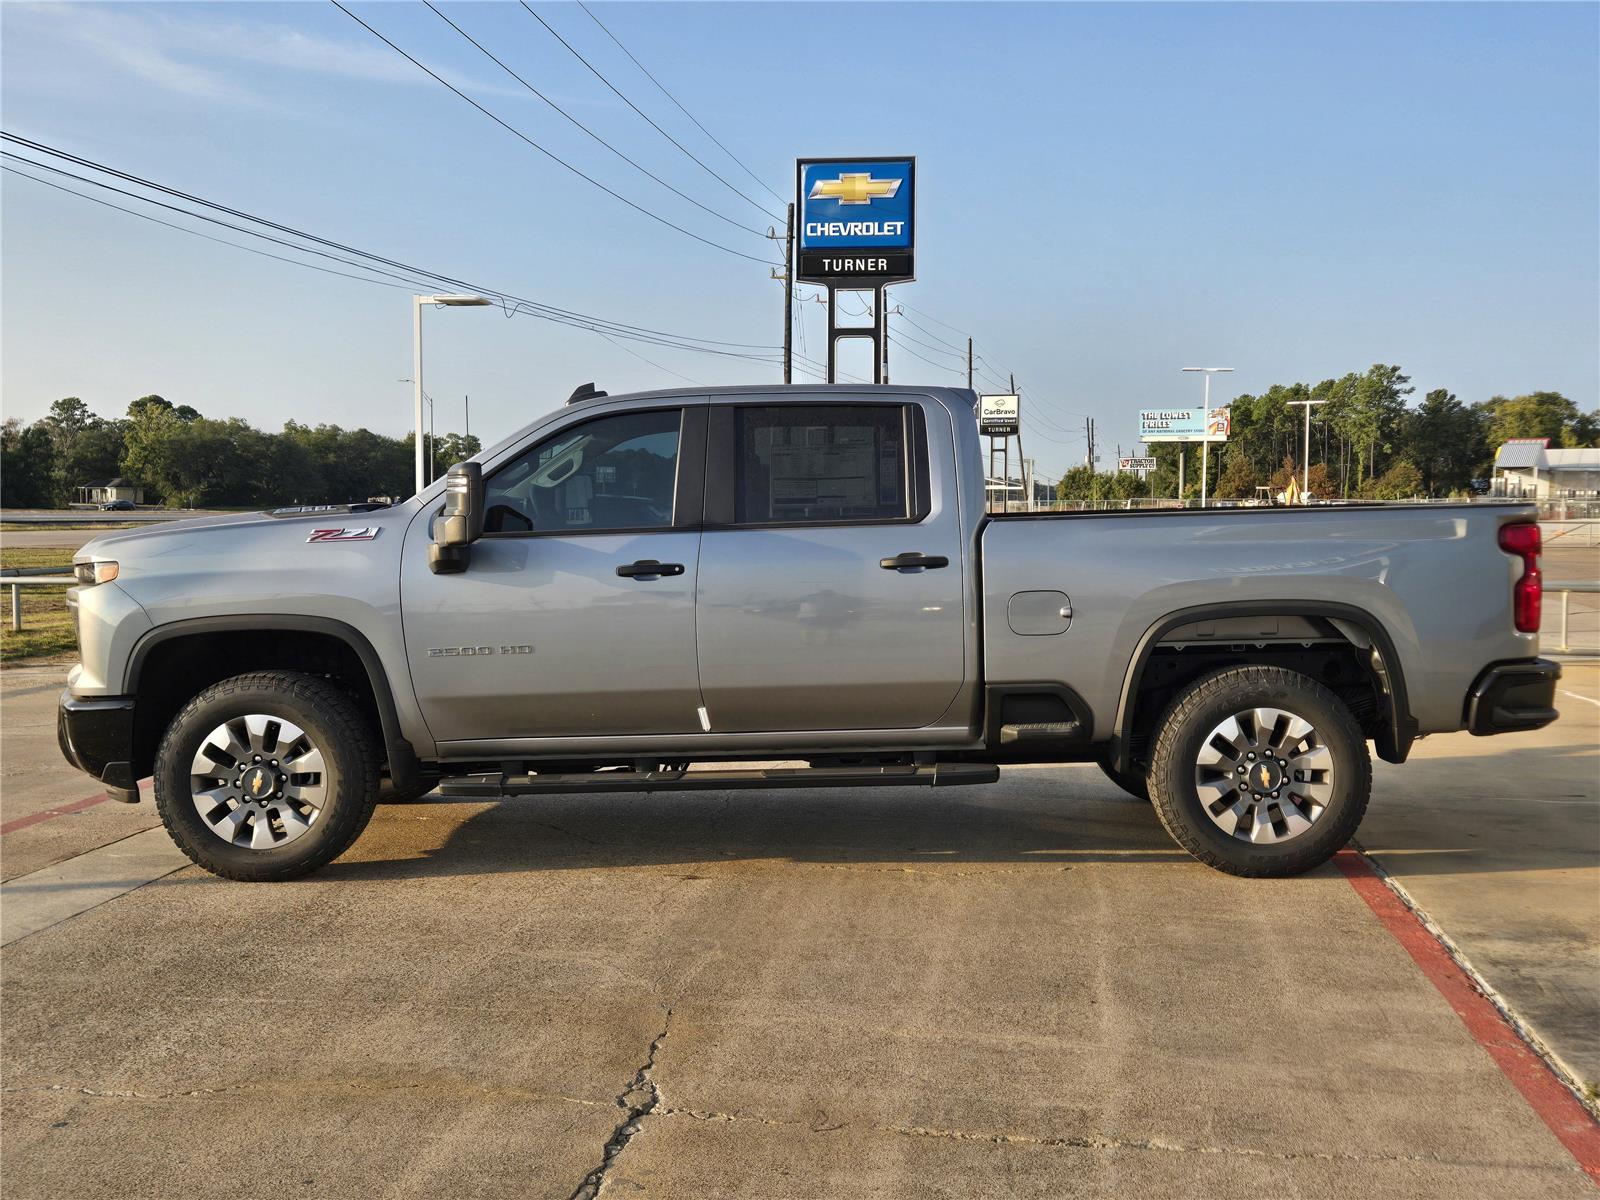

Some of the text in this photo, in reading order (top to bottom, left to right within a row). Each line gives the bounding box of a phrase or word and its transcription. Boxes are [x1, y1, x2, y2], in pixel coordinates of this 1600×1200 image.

[806, 221, 905, 237] CHEVROLET
[822, 258, 888, 272] TURNER
[1142, 420, 1172, 429] PRICES
[305, 526, 381, 543] Z71
[426, 645, 534, 657] 2500 HD
